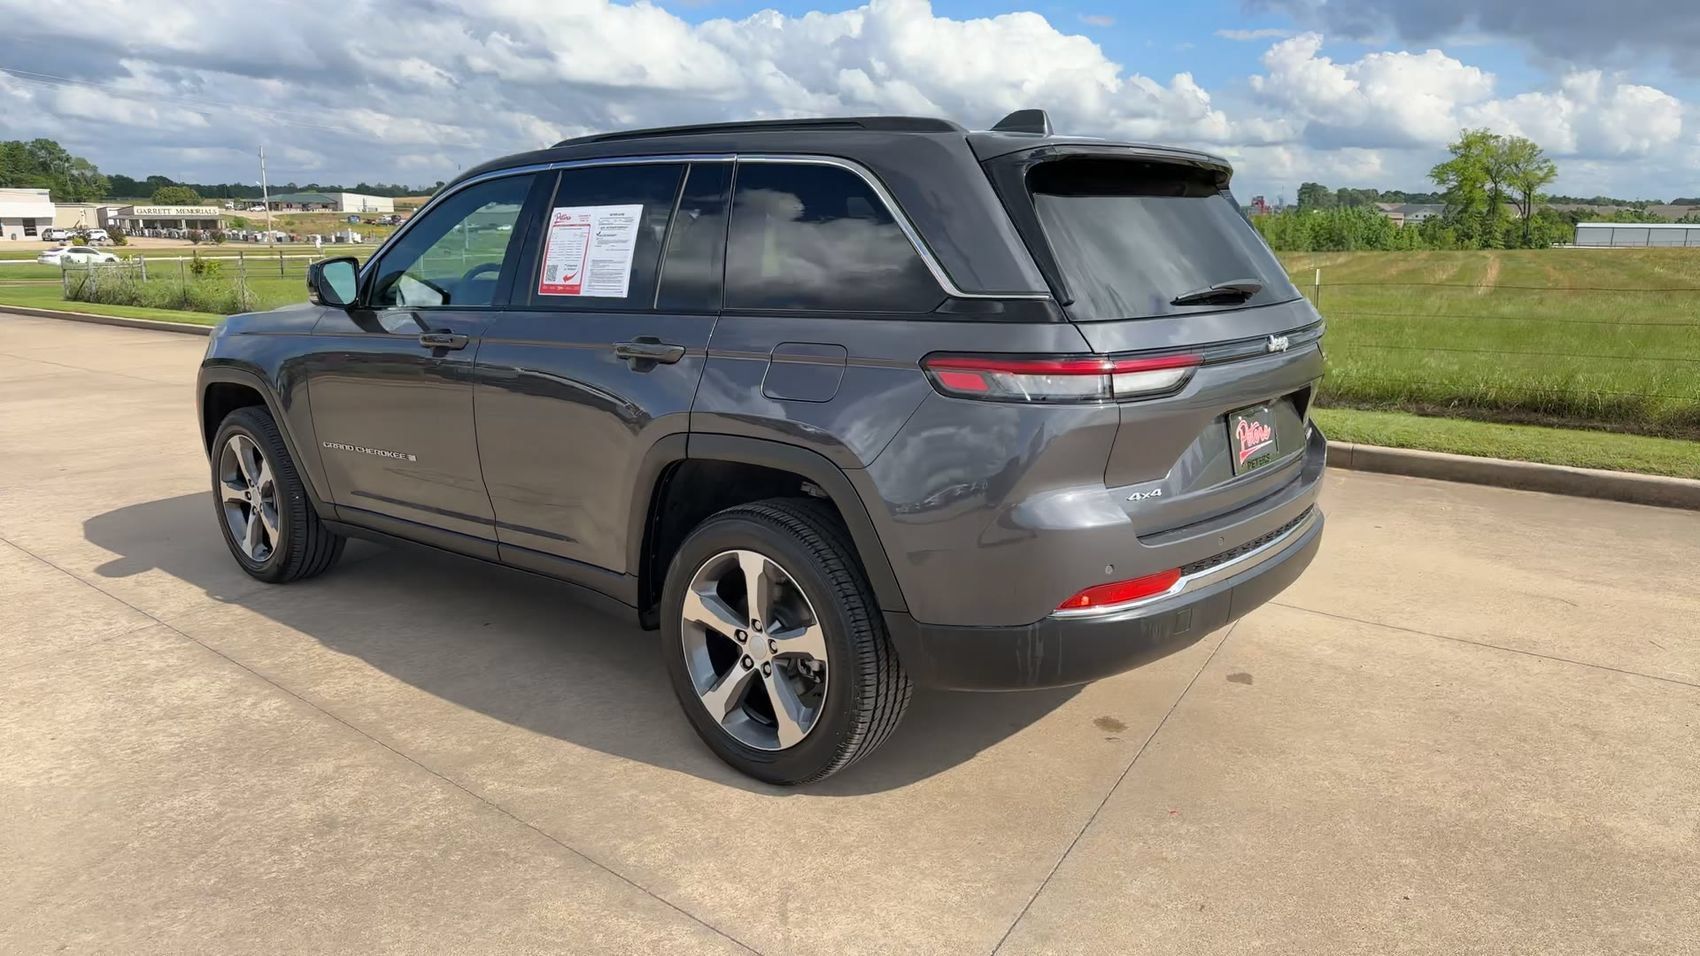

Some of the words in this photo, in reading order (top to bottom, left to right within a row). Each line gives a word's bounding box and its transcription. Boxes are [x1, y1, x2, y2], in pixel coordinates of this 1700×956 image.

[1268, 335, 1289, 352] Jeep
[1236, 420, 1271, 451] Peters
[323, 441, 354, 451] GRAND
[355, 446, 406, 459] CHEROKEE
[1247, 453, 1271, 469] PETERS
[1127, 489, 1162, 501] 4x4
